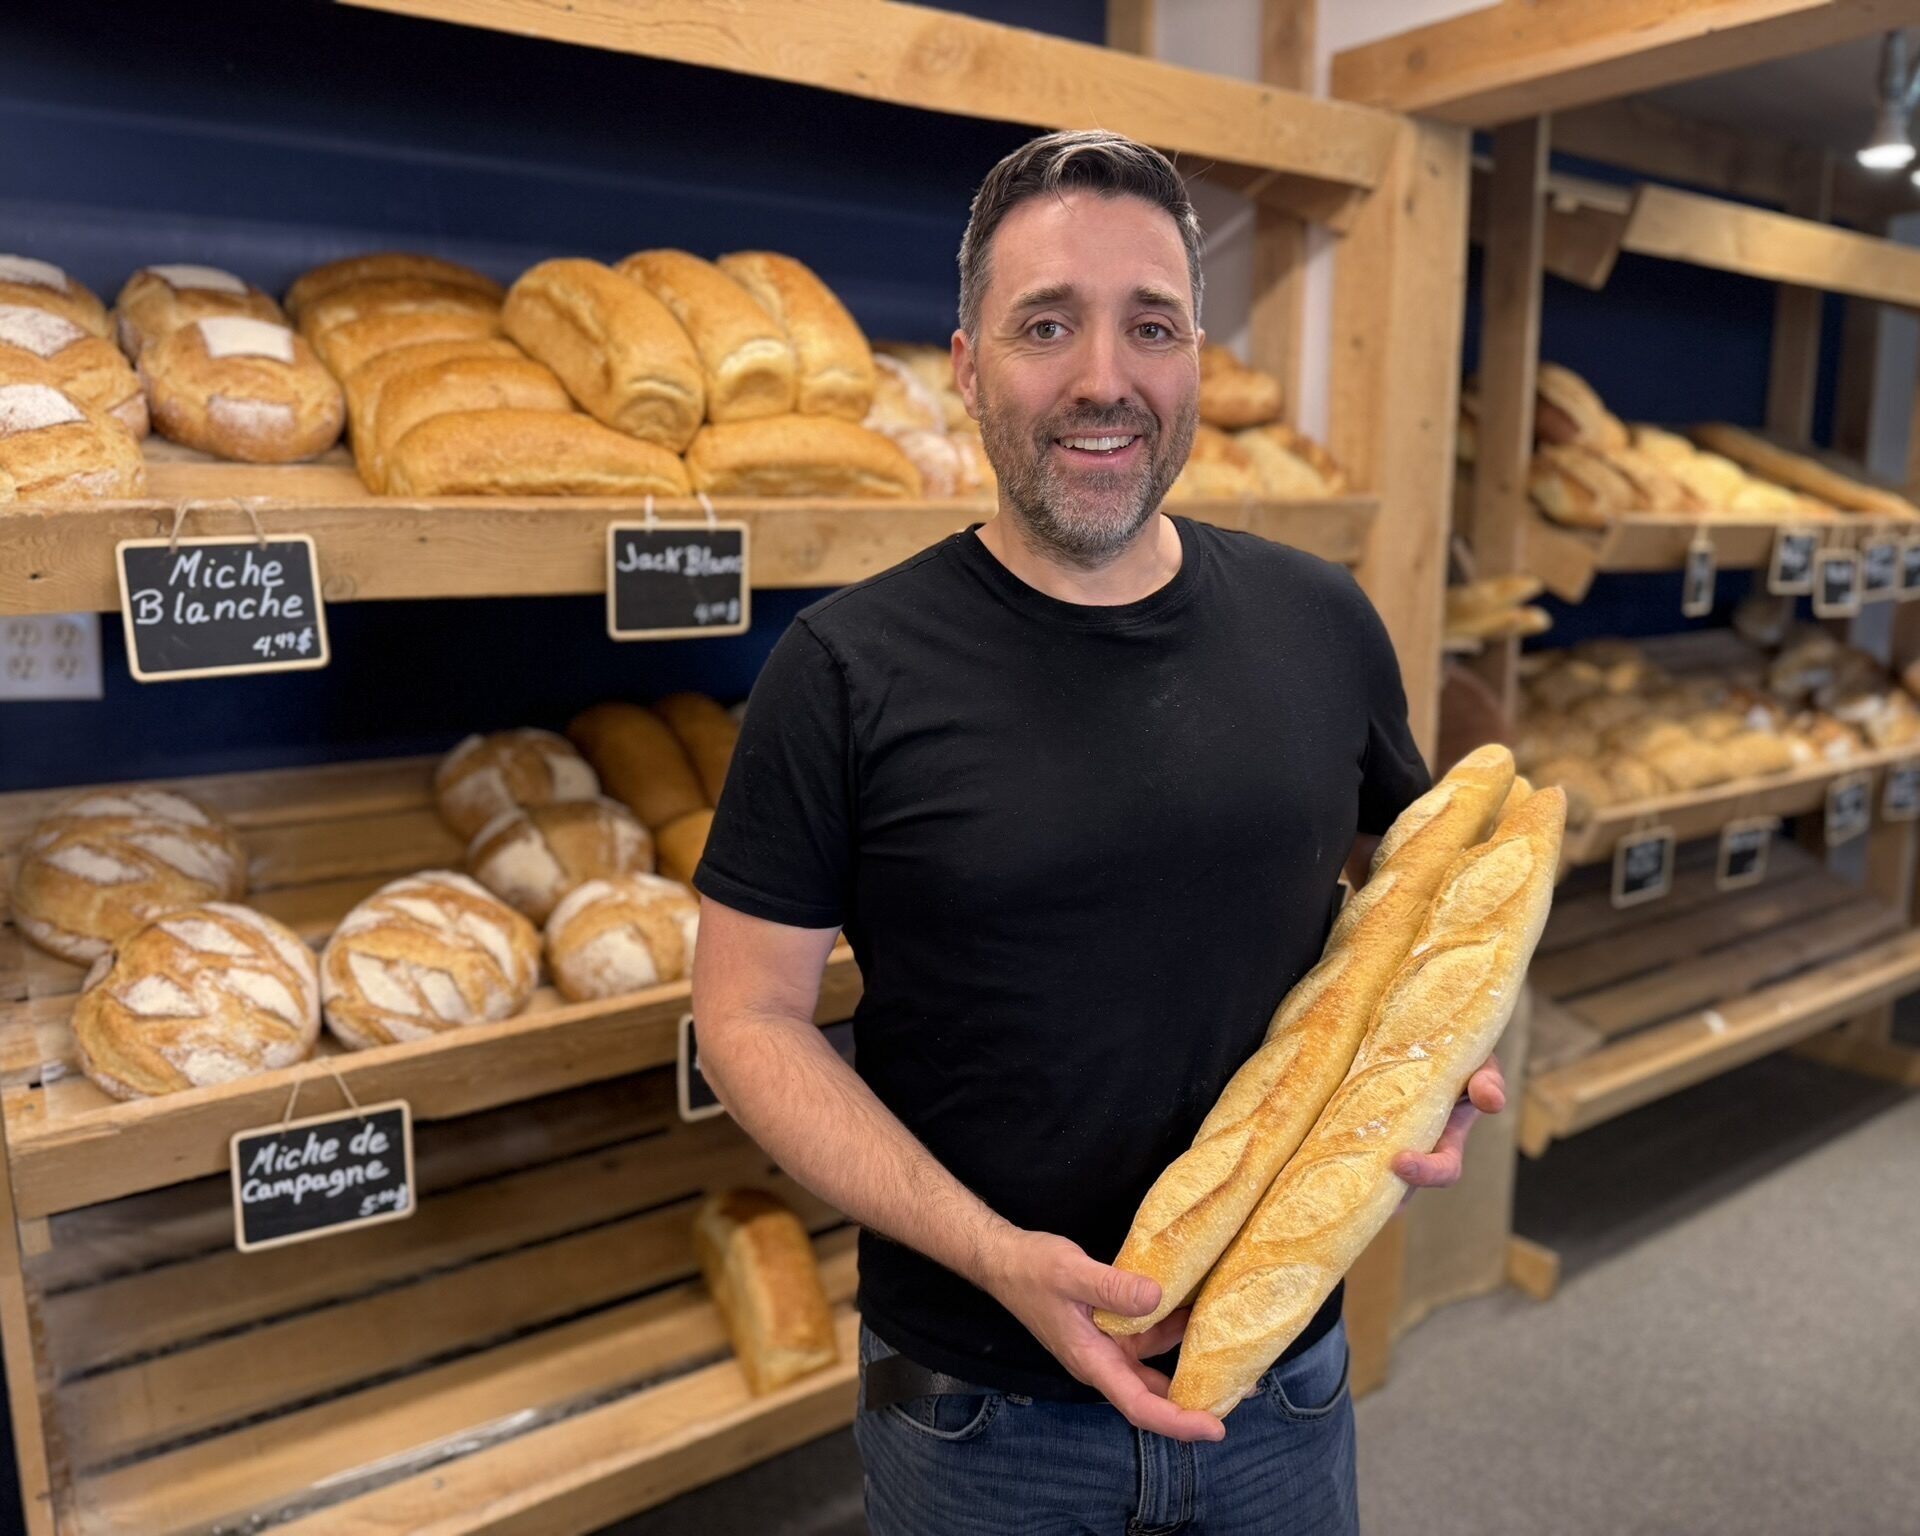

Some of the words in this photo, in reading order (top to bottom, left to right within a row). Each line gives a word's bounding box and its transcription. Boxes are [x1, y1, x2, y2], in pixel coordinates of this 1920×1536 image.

[169, 550, 285, 589] Miche
[131, 587, 304, 625] Blanche
[248, 1132, 340, 1177] Miche
[349, 1122, 390, 1156] de
[242, 1160, 391, 1205] Campagne
